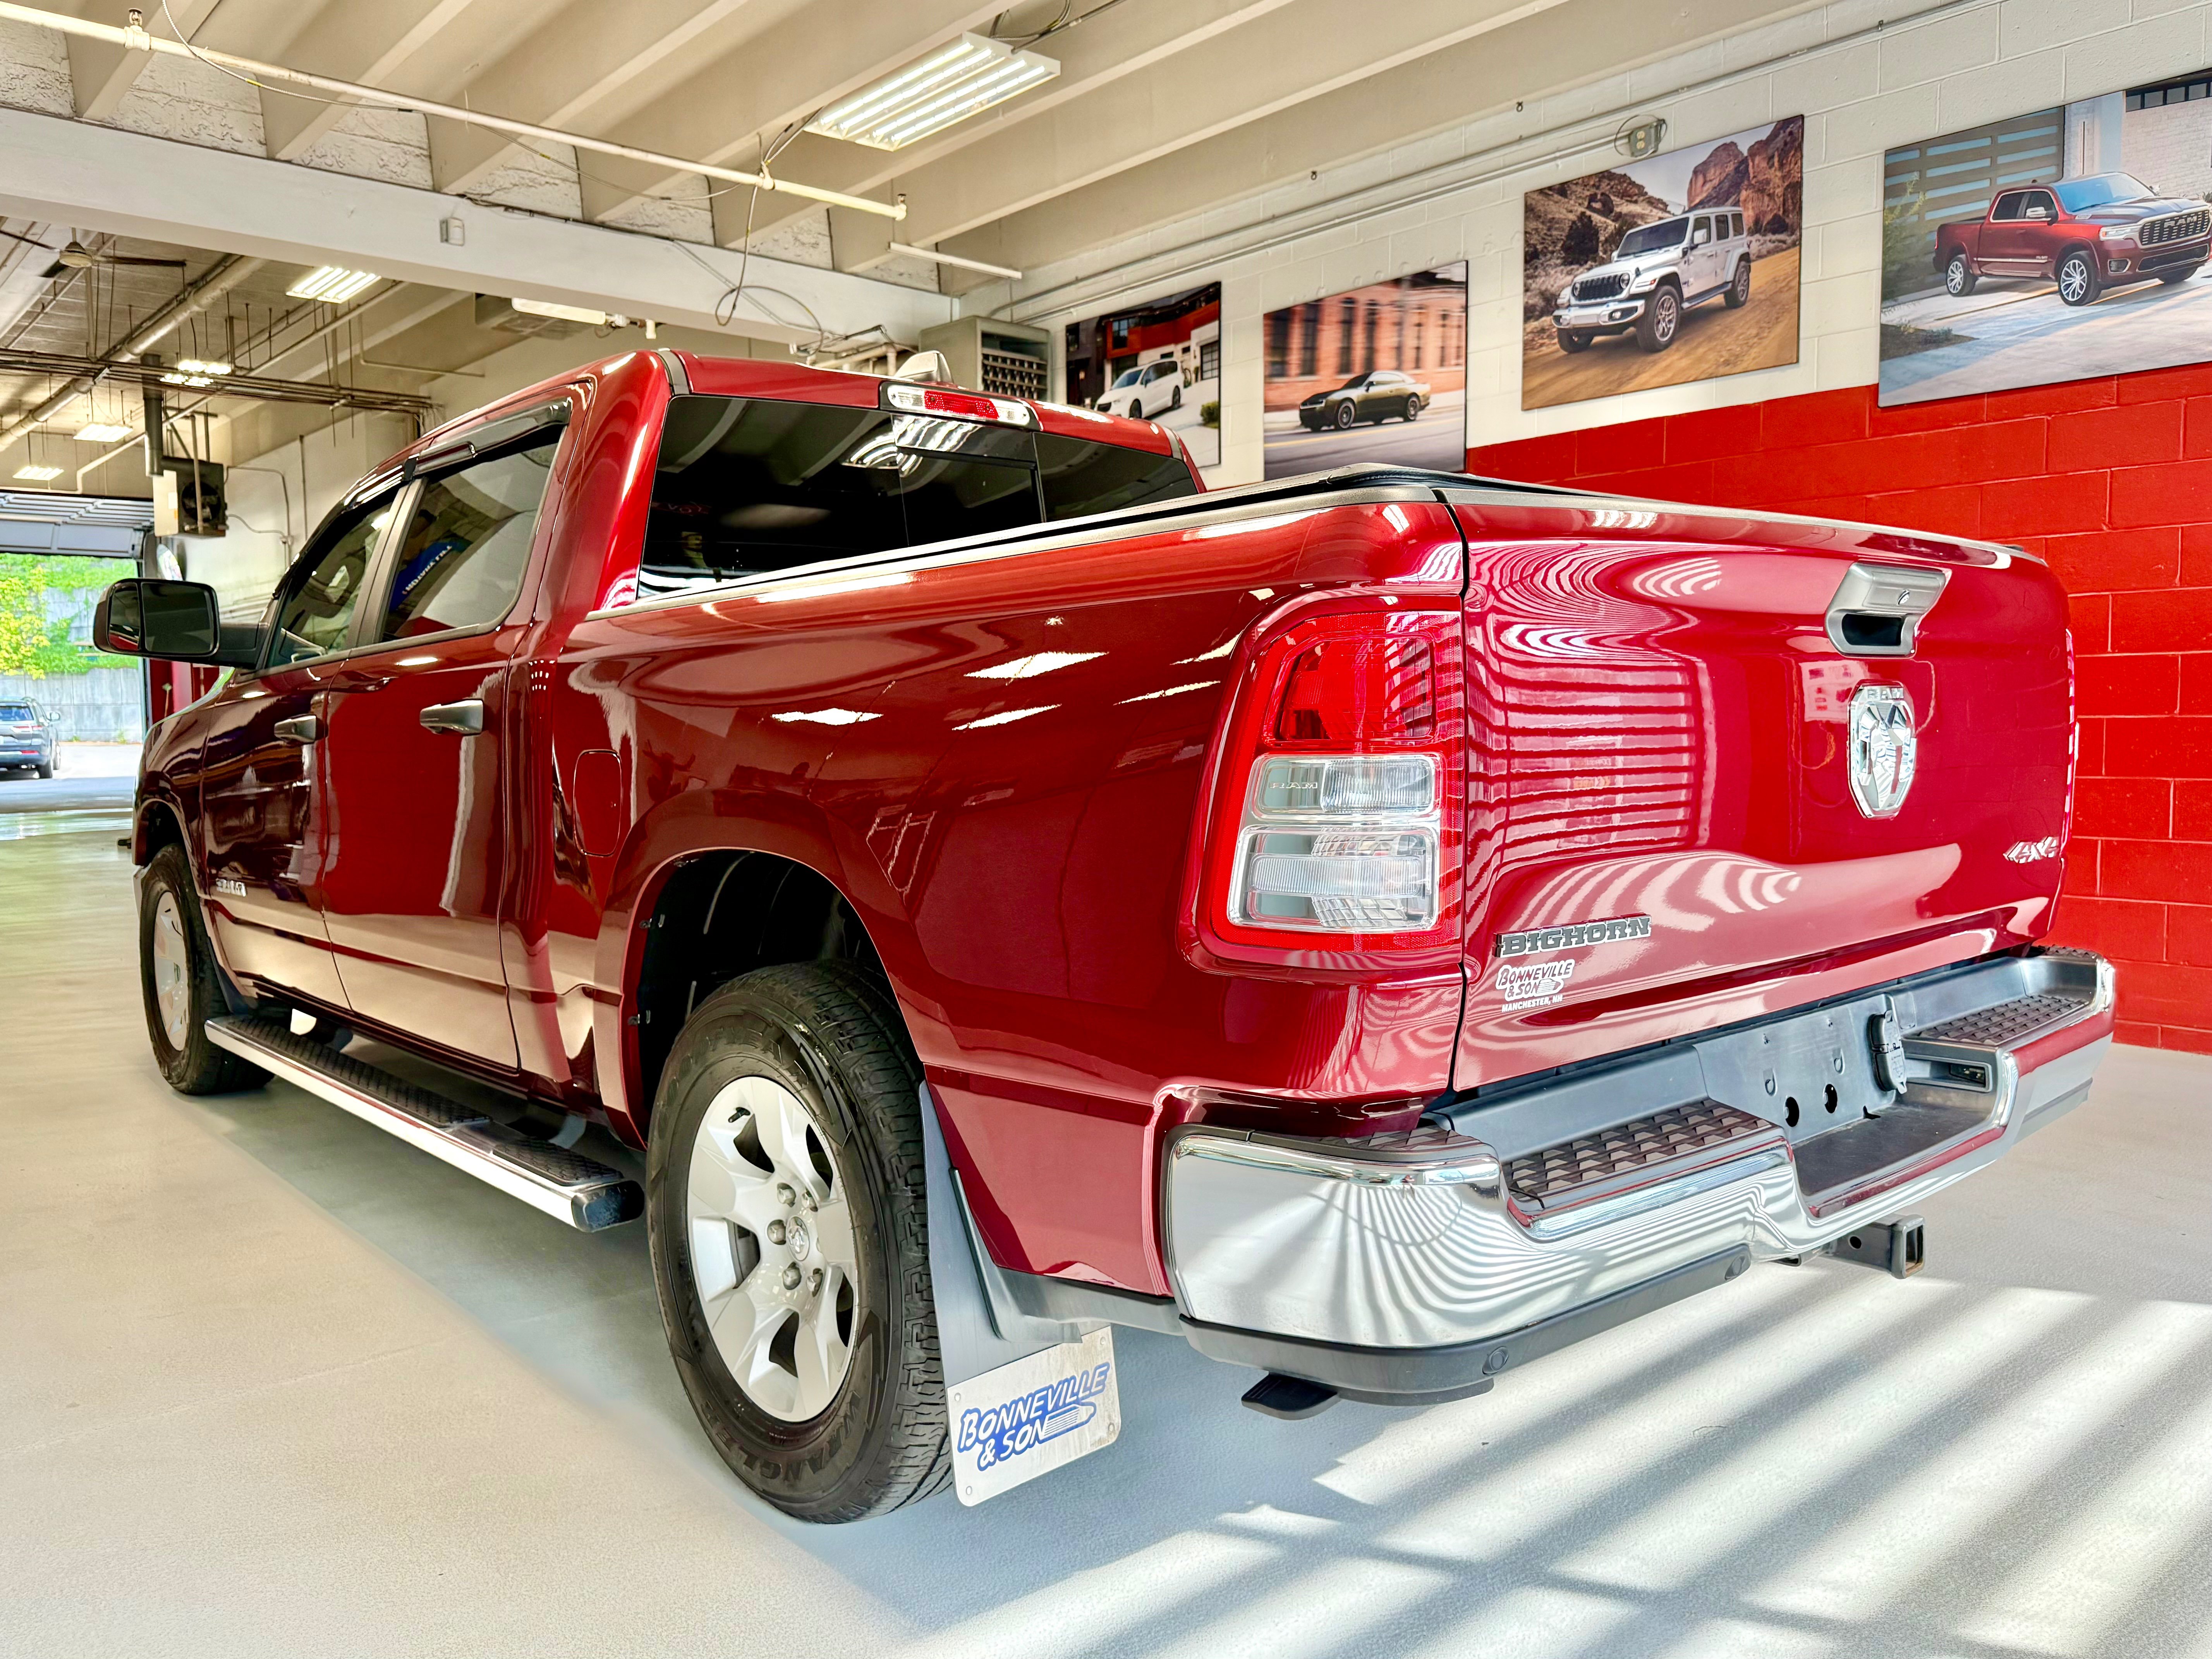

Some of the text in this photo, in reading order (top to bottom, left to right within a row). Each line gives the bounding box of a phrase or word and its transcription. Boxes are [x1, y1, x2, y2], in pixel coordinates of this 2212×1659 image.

[2164, 215, 2197, 228] RAM
[1500, 915, 1652, 958] BIGHORN
[1498, 962, 1572, 986] BONNEVILLE
[1507, 981, 1540, 998] & SON
[1501, 994, 1563, 1013] MANCHESTER, NH
[959, 1365, 1109, 1449] BONNEVILLE
[979, 1417, 1048, 1468] & SON
